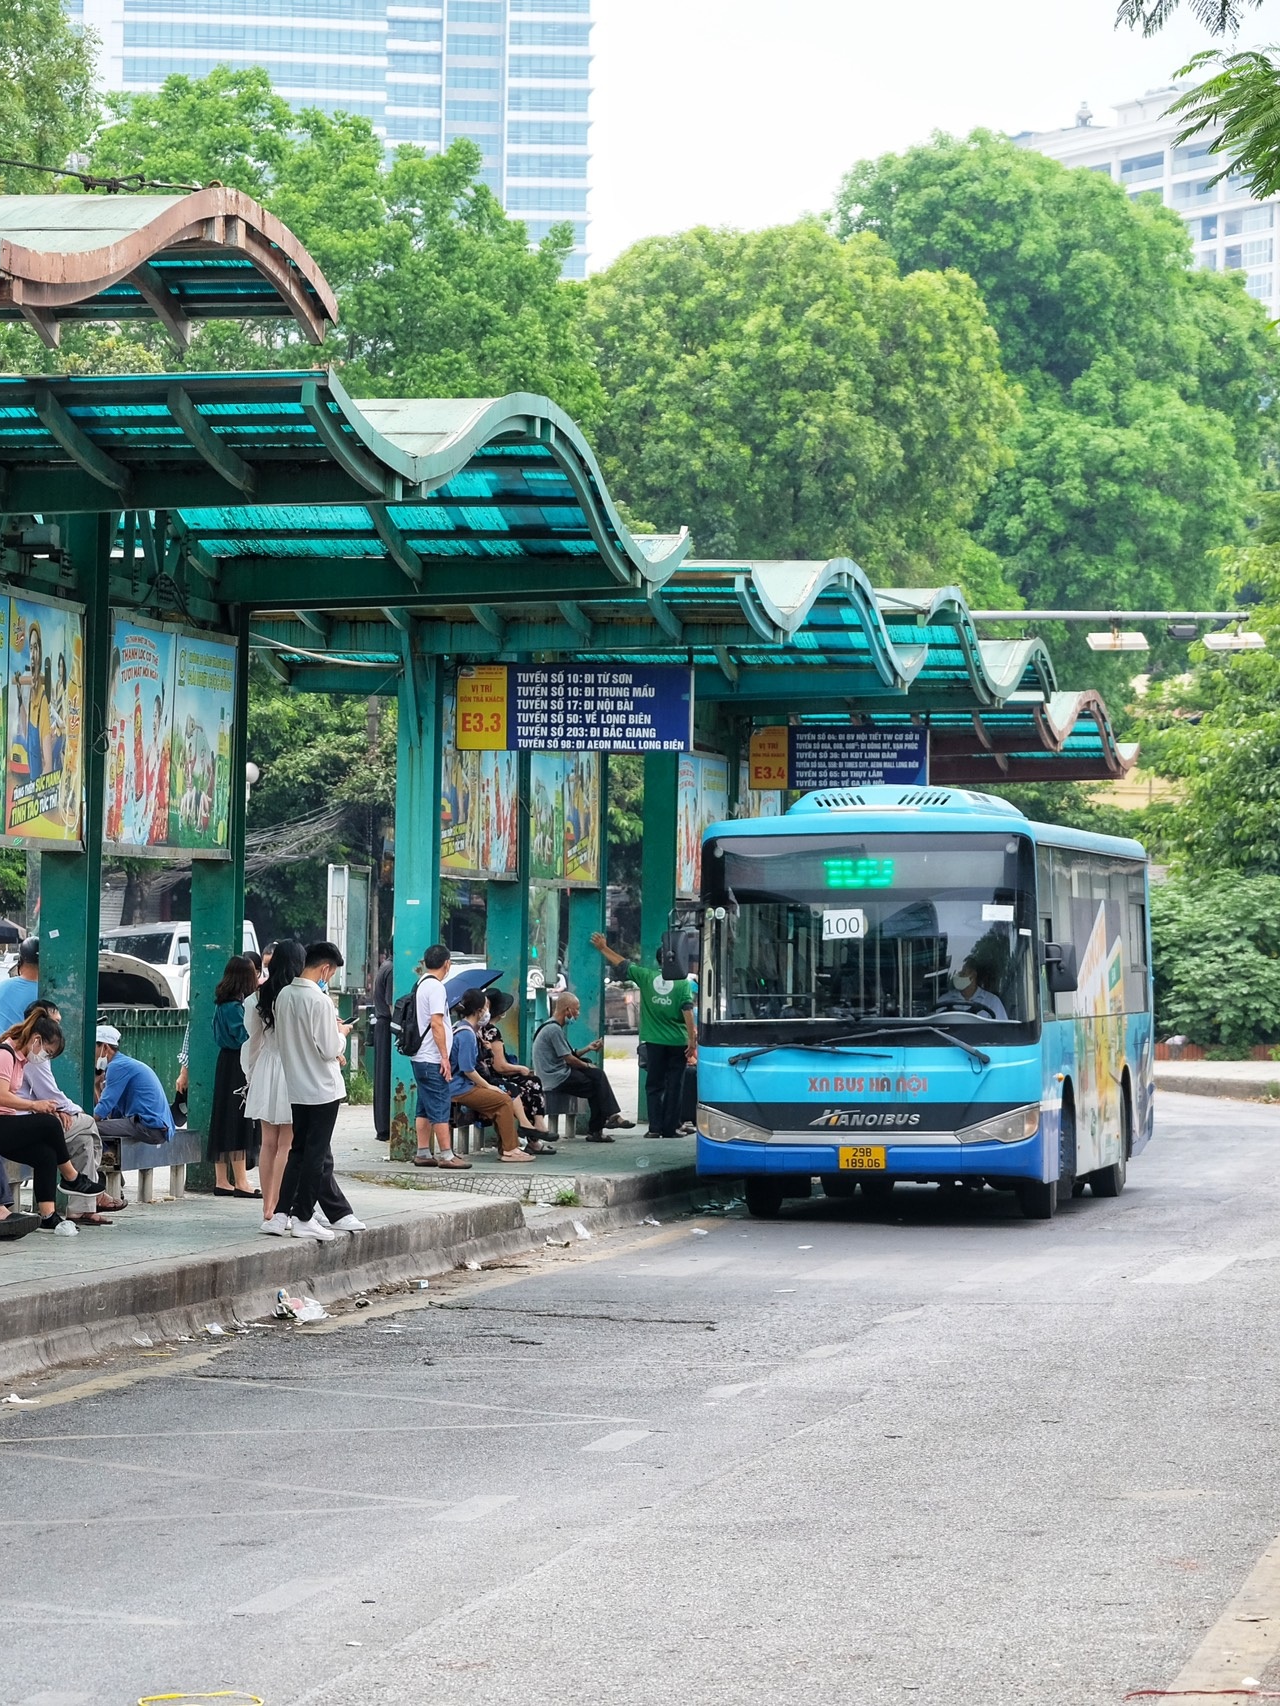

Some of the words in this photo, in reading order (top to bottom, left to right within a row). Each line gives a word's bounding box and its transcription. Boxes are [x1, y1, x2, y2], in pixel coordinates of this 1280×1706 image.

[517, 670, 548, 684] TUYẾN
[550, 670, 565, 684] SỐ
[567, 673, 582, 684] 10:
[598, 672, 610, 684] TỪ
[612, 672, 632, 684] SƠN
[472, 684, 478, 694] VỊ
[480, 683, 492, 693] TRÍ
[517, 684, 548, 697] TUYẾN
[550, 684, 565, 697] SỐ
[567, 687, 582, 697] 10:
[598, 687, 630, 697] TRUNG
[517, 698, 548, 710] TUYẾN
[550, 698, 565, 710] SỐ
[566, 700, 582, 710] 17:
[584, 700, 594, 710] ĐI
[597, 698, 614, 712] NỘI
[616, 698, 634, 711] BÀI
[462, 712, 502, 732] E3.3
[517, 710, 548, 724] TUYẾN
[550, 710, 565, 724] SỐ
[566, 714, 582, 724] 50:
[601, 714, 626, 724] LONG
[628, 712, 652, 724] BIÊN
[517, 724, 548, 737] TUYẾN
[550, 724, 565, 737] SỐ
[566, 726, 588, 737] 203:
[590, 727, 601, 738] ĐI
[602, 724, 622, 738] BẮC
[626, 728, 656, 738] GIANG
[518, 737, 545, 748] TUYẾN
[547, 737, 558, 748] SỐ
[587, 740, 611, 750] AEON
[614, 740, 636, 750] MALL
[638, 740, 661, 750] LONG
[663, 738, 684, 750] BIÊN
[754, 766, 786, 780] E3.4
[824, 917, 860, 934] 100
[652, 996, 672, 1006] Grab
[834, 1077, 864, 1092] BUS
[870, 1073, 891, 1092] HÀ
[852, 1148, 872, 1157] 29B
[846, 1158, 880, 1168] 189.06
